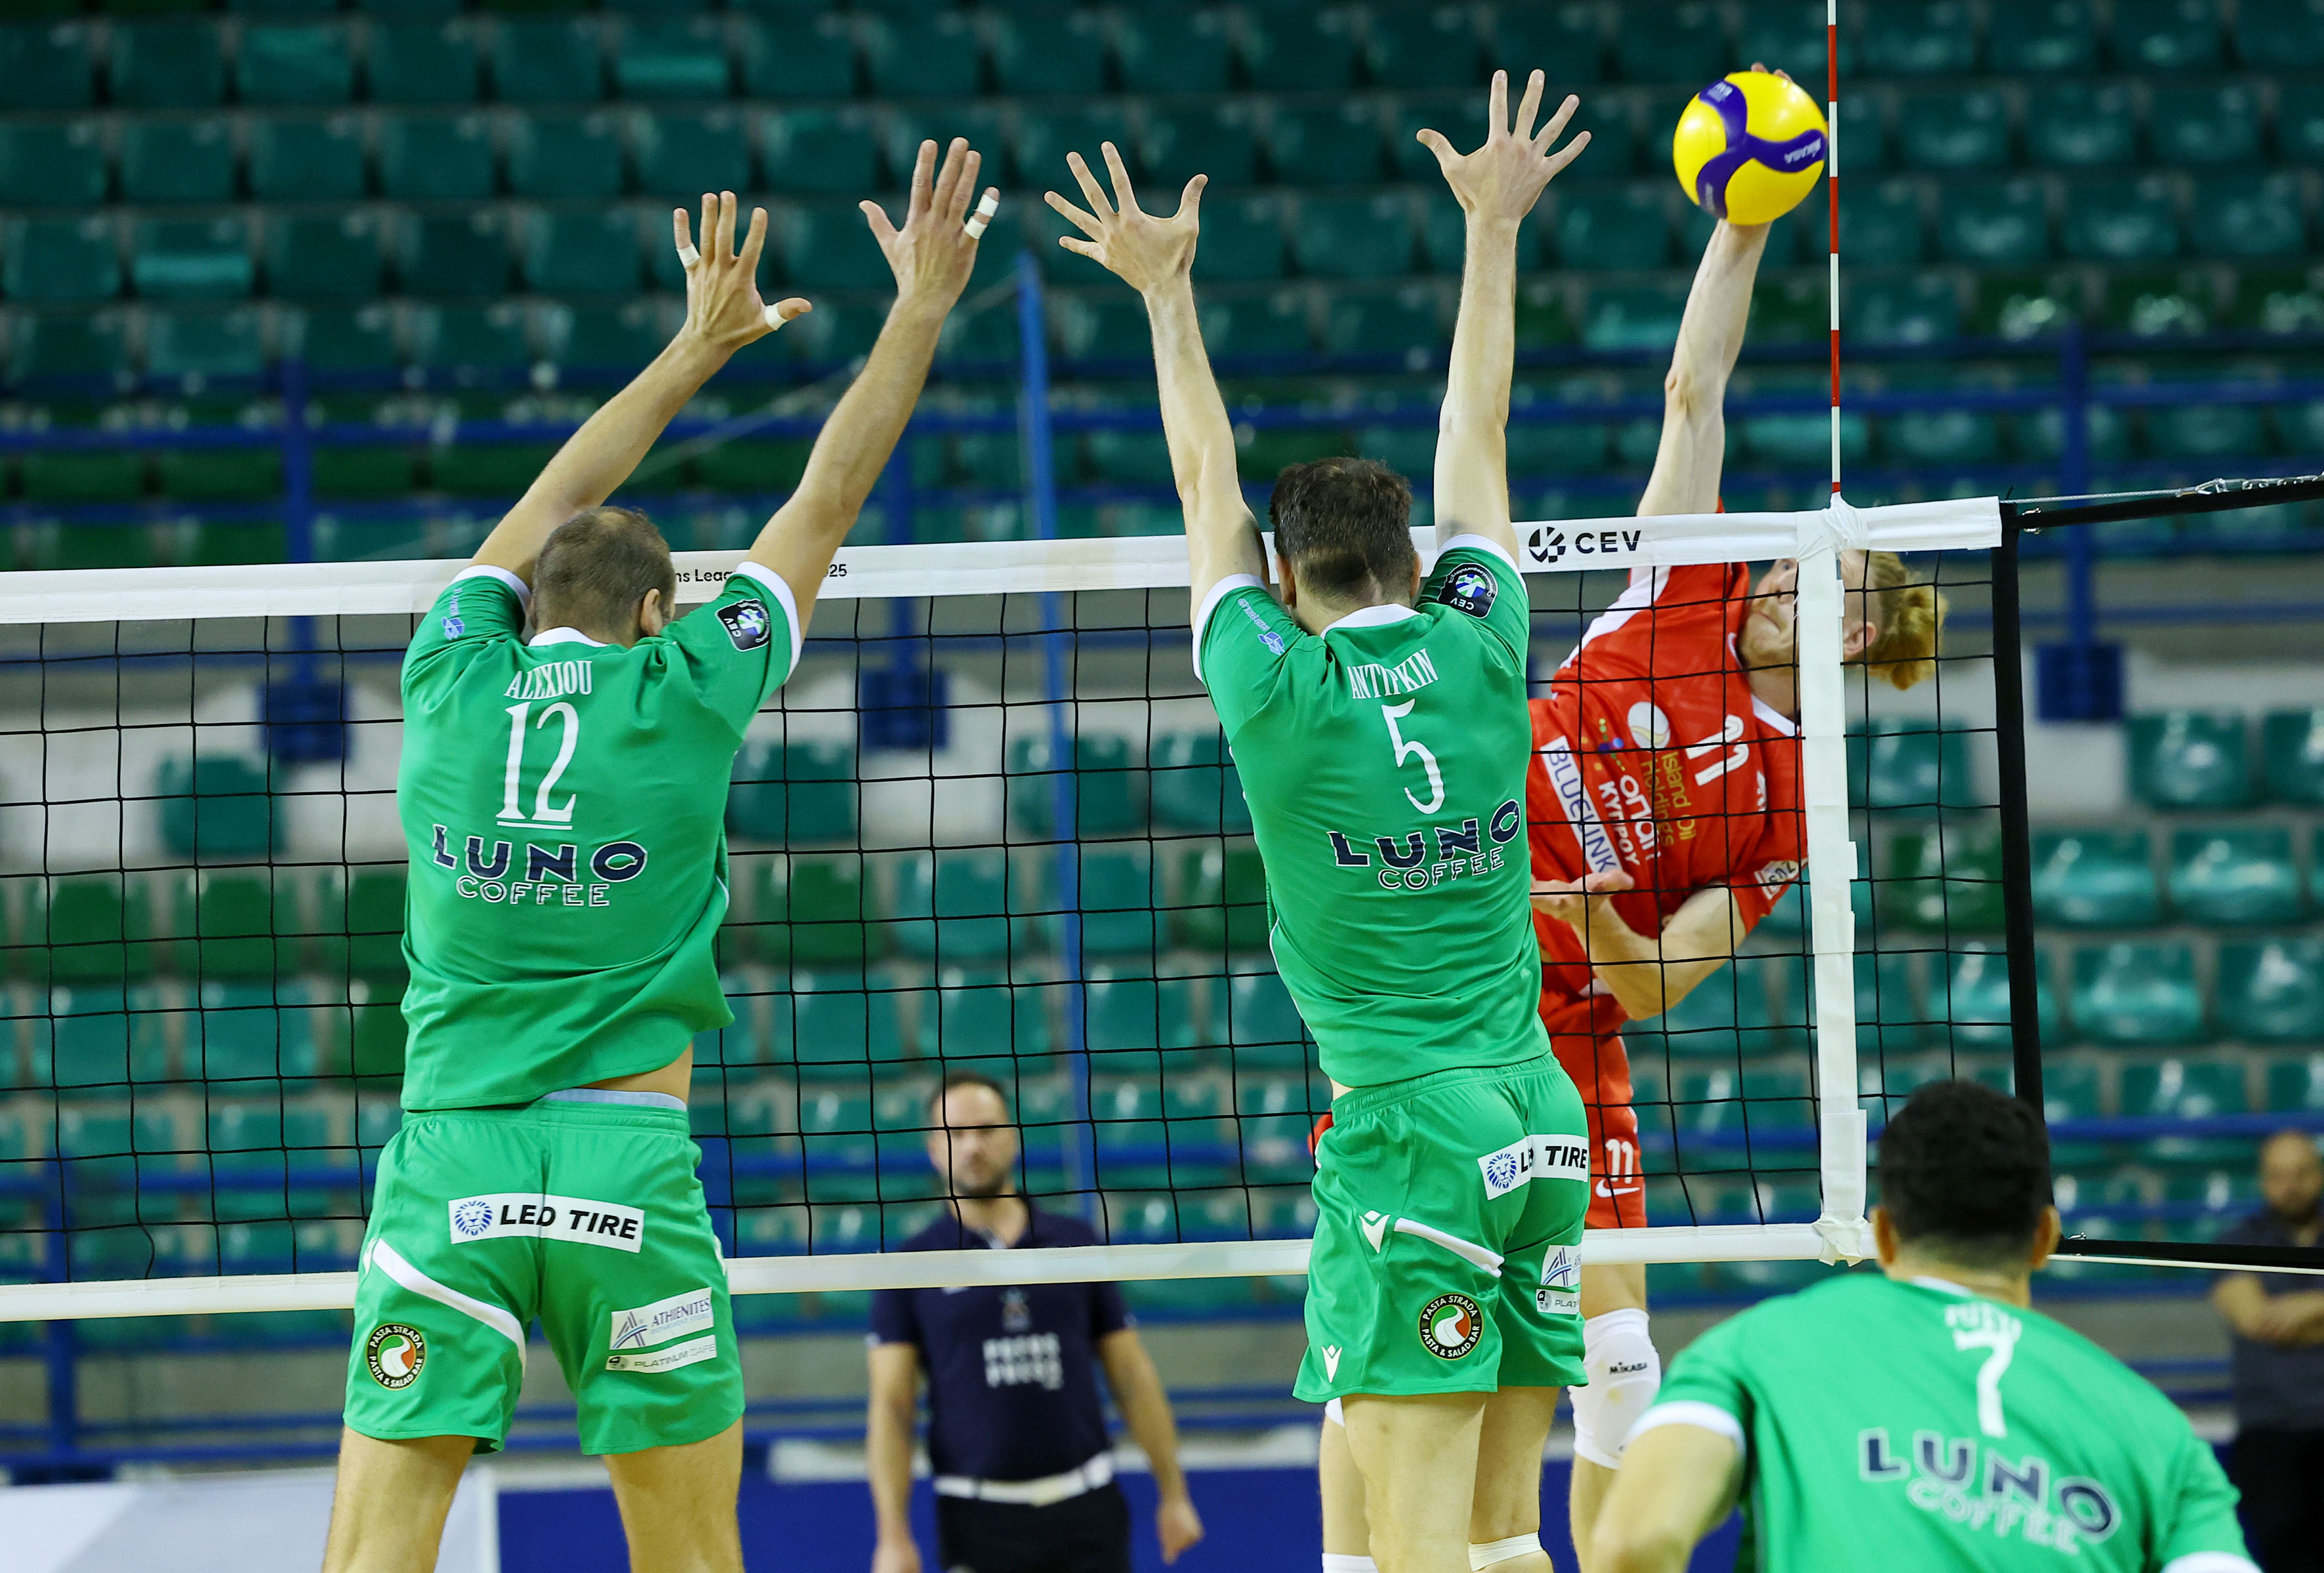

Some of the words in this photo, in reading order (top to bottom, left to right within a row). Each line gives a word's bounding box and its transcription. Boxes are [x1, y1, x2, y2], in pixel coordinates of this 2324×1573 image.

[1575, 530, 1641, 554] CEV
[825, 563, 847, 578] 25
[1450, 597, 1475, 610] CEV
[724, 618, 742, 638] CEV
[502, 660, 593, 700] ALEXIOU
[1347, 648, 1438, 699] ANTIPKIN
[495, 701, 580, 823] 12
[1381, 698, 1445, 815] 5
[1684, 714, 1750, 786] 11
[1661, 751, 1692, 808] Island
[1677, 814, 1697, 840] Oil
[1326, 798, 1521, 870] LUNO
[432, 824, 648, 883] LUNO
[1378, 846, 1505, 890] COFFEE
[455, 875, 610, 907] COFFEE
[1545, 1145, 1588, 1170] TIRE
[1604, 1138, 1634, 1185] 11
[569, 1209, 639, 1240] TIRE
[1422, 1297, 1447, 1320] PASTA
[1448, 1296, 1478, 1317] STRADA
[1555, 1299, 1580, 1308] PLAT
[369, 1327, 393, 1348] PASTA
[392, 1326, 423, 1349] STRADA
[1421, 1328, 1439, 1353] PASTA
[1447, 1342, 1471, 1357] SALAD
[1468, 1325, 1480, 1343] BAR
[369, 1355, 384, 1381] PASTA
[390, 1374, 415, 1388] SALAD
[411, 1358, 424, 1375] BAR
[1953, 1329, 2015, 1439] 7
[1858, 1426, 2122, 1543] LUNO
